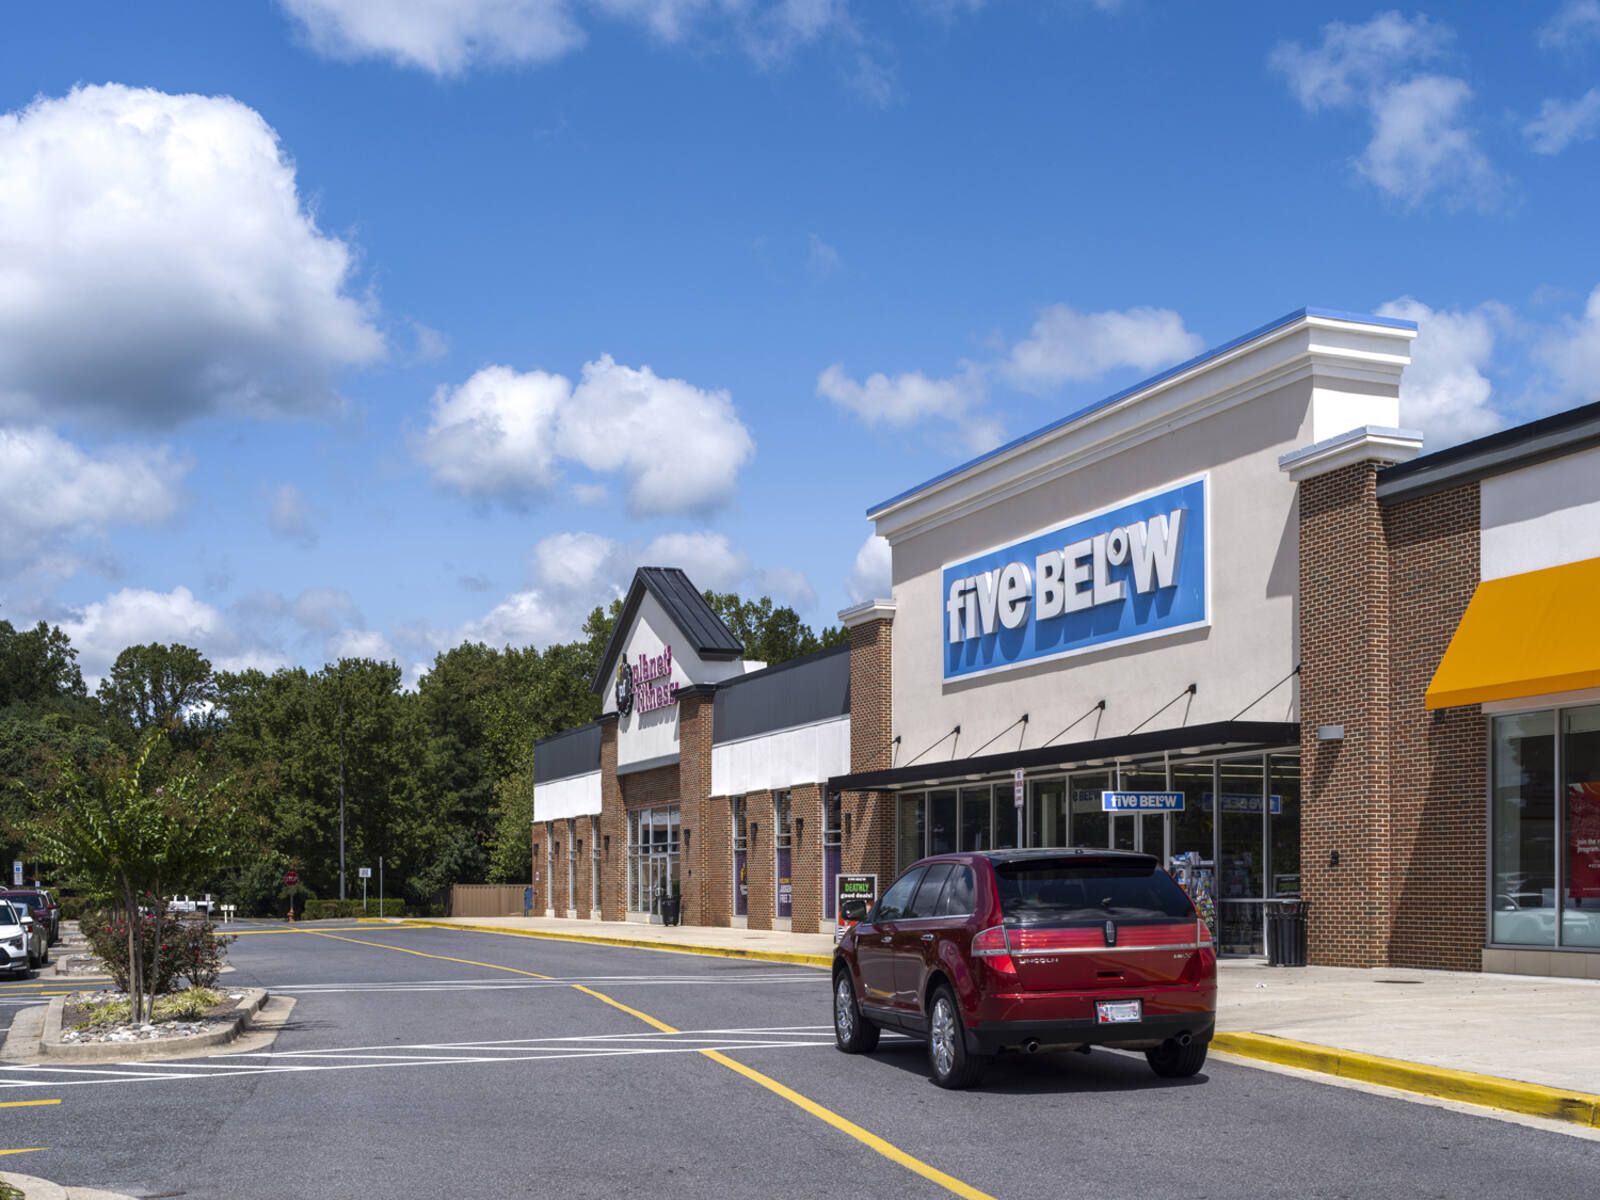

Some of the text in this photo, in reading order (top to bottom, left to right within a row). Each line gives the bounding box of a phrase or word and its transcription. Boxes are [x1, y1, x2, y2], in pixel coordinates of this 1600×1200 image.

[947, 561, 1032, 643] five
[632, 645, 672, 694] planet
[1111, 795, 1138, 808] five
[845, 883, 869, 892] DEATHLY
[1019, 957, 1059, 965] LINCOLN
